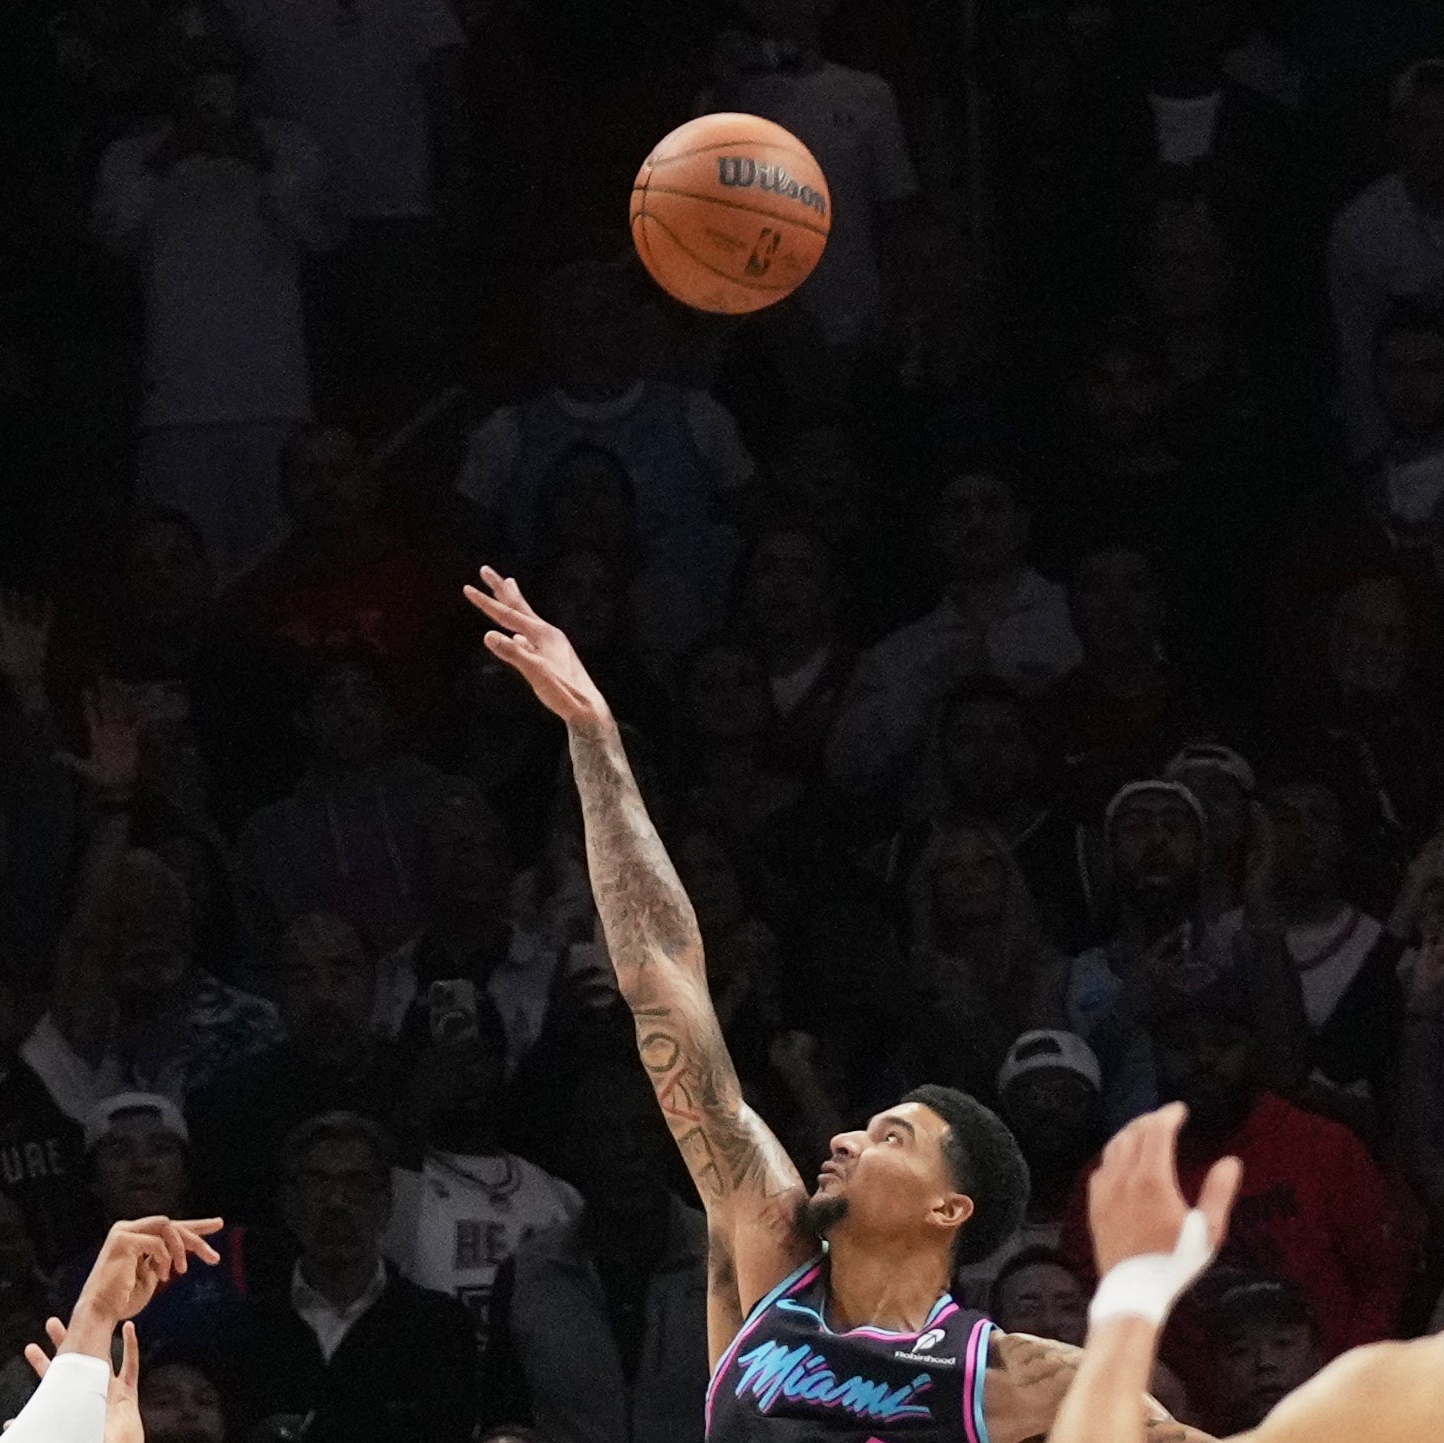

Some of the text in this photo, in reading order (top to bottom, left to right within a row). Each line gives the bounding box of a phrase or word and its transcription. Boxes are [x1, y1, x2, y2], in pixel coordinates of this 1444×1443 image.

[718, 156, 827, 218] Wilson
[735, 1339, 933, 1422] Miami
[894, 1349, 956, 1366] Robinhood
